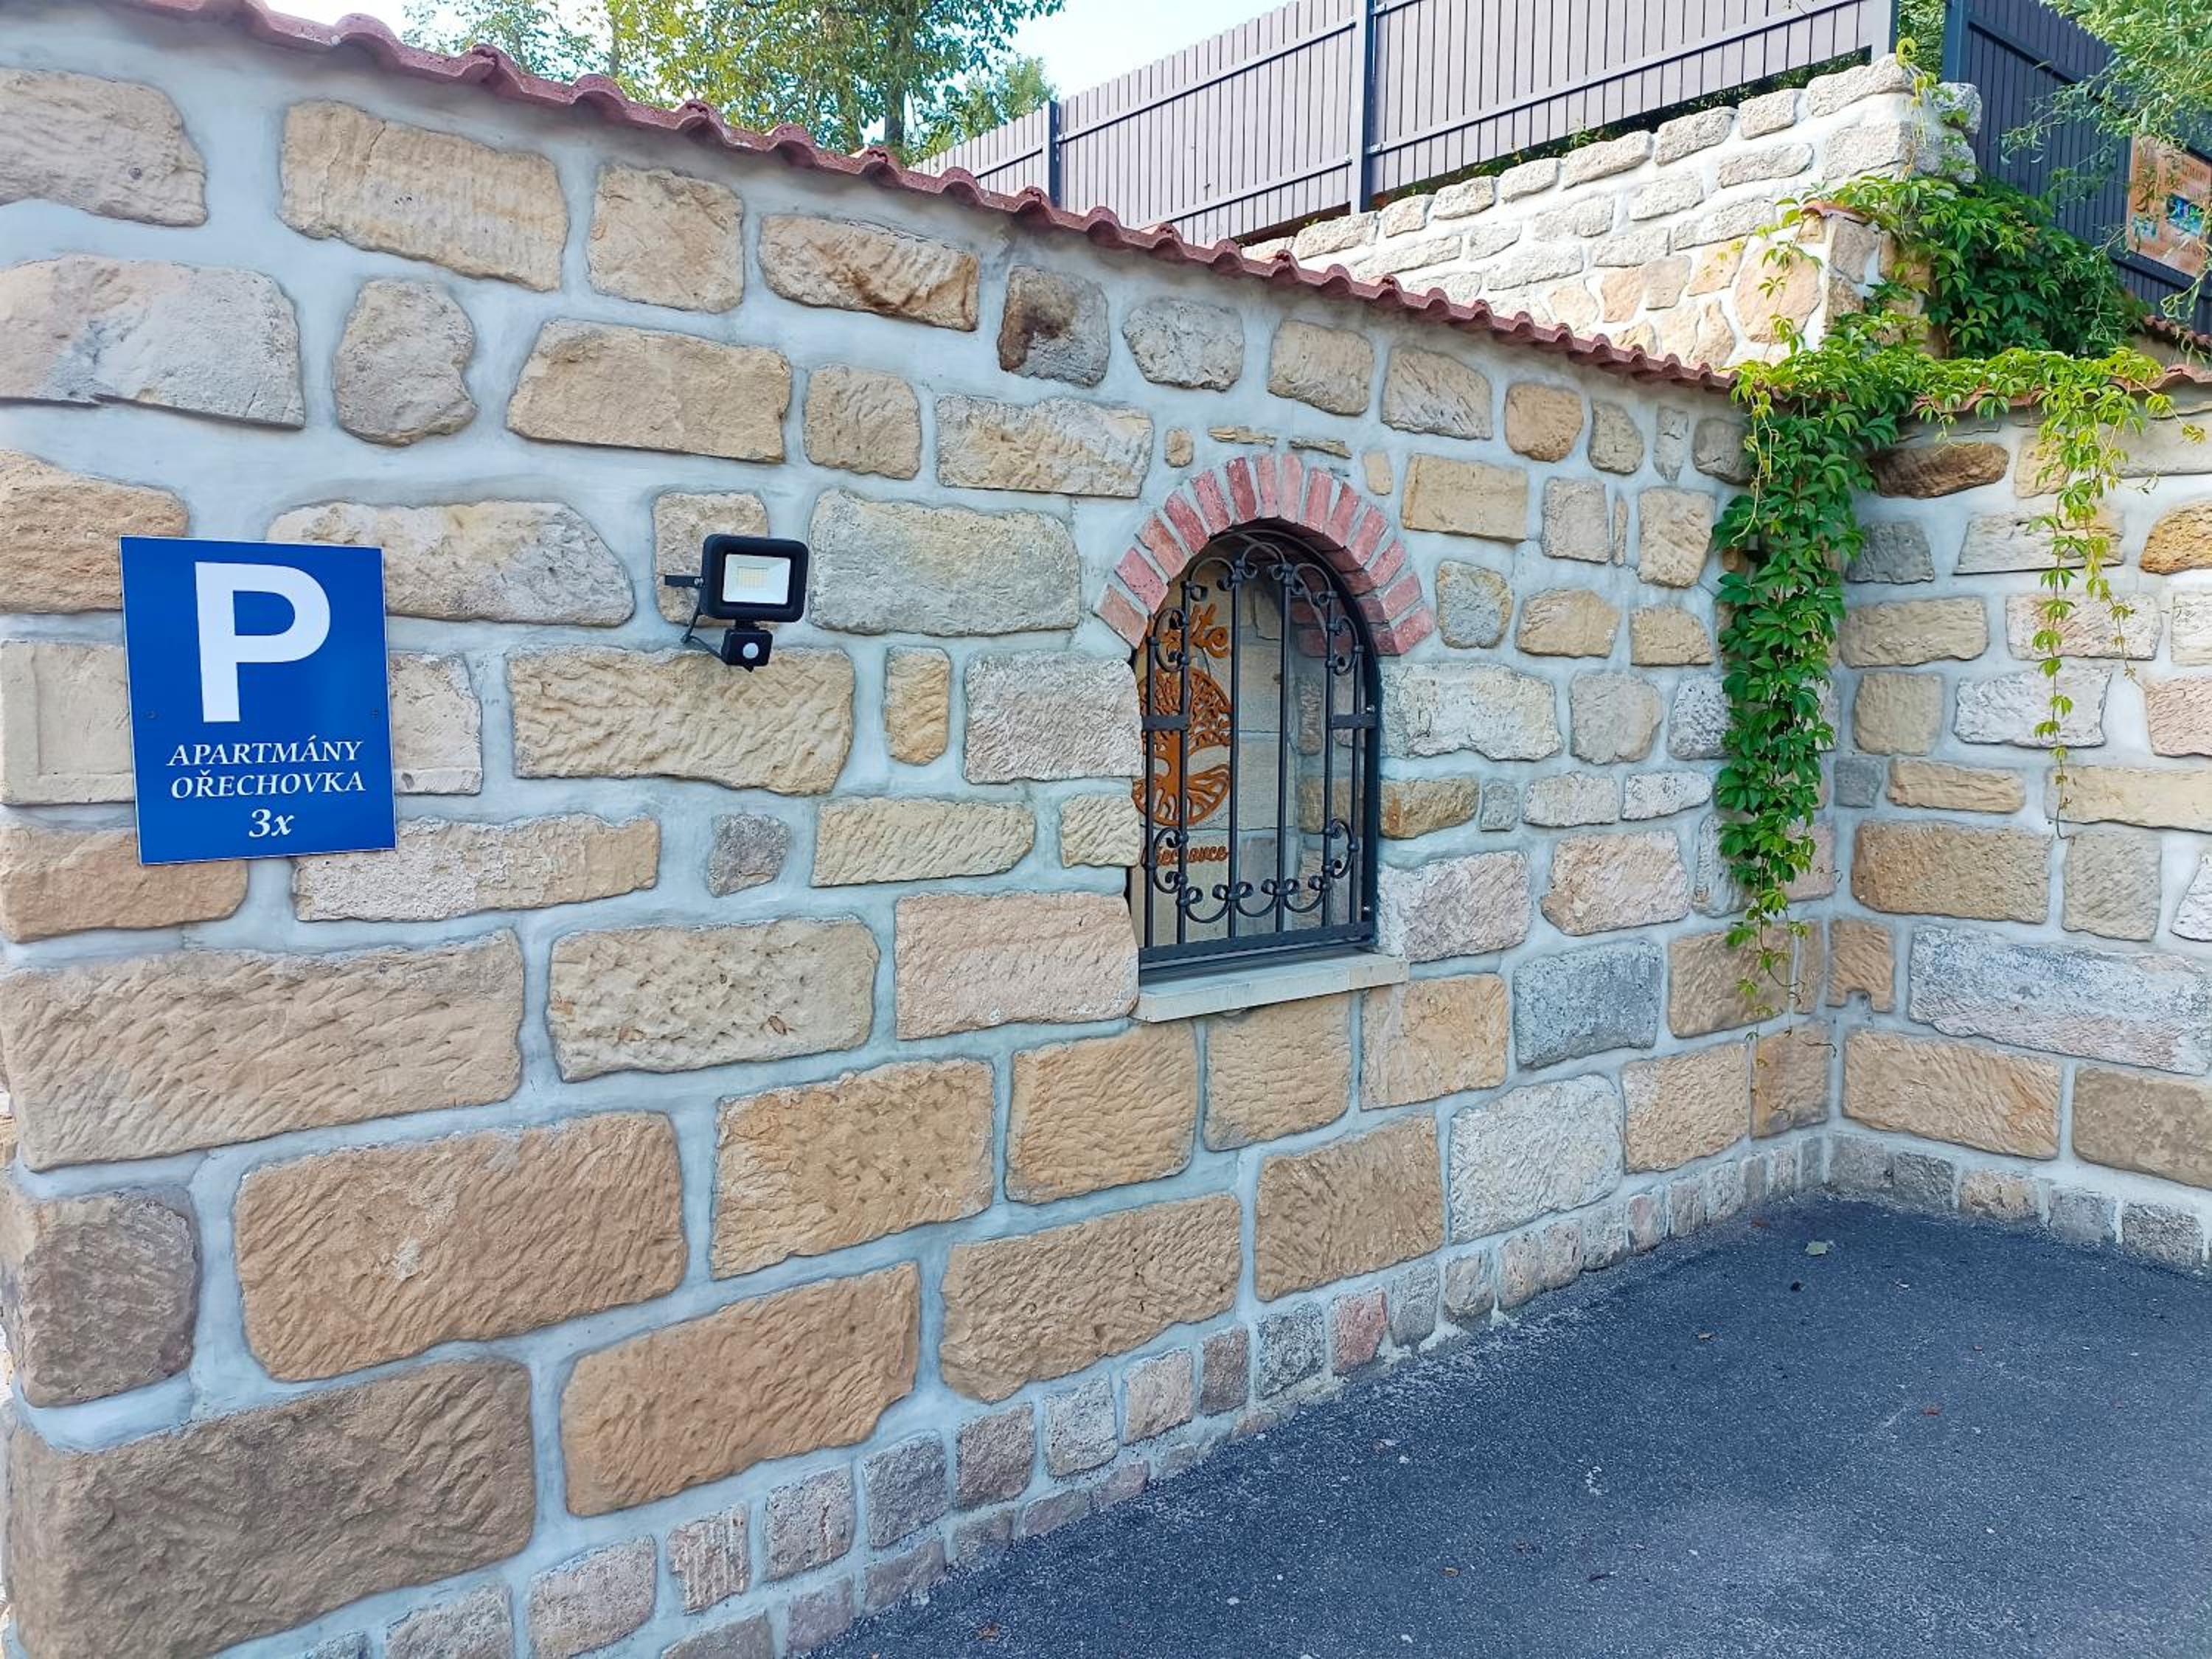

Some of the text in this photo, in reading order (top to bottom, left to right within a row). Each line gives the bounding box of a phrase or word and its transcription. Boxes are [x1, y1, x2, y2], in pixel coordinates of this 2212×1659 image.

[195, 562, 331, 723] P
[167, 735, 364, 766] APARTMÁNY
[171, 770, 365, 799] OŘECHOVKA
[248, 809, 294, 838] 3x
